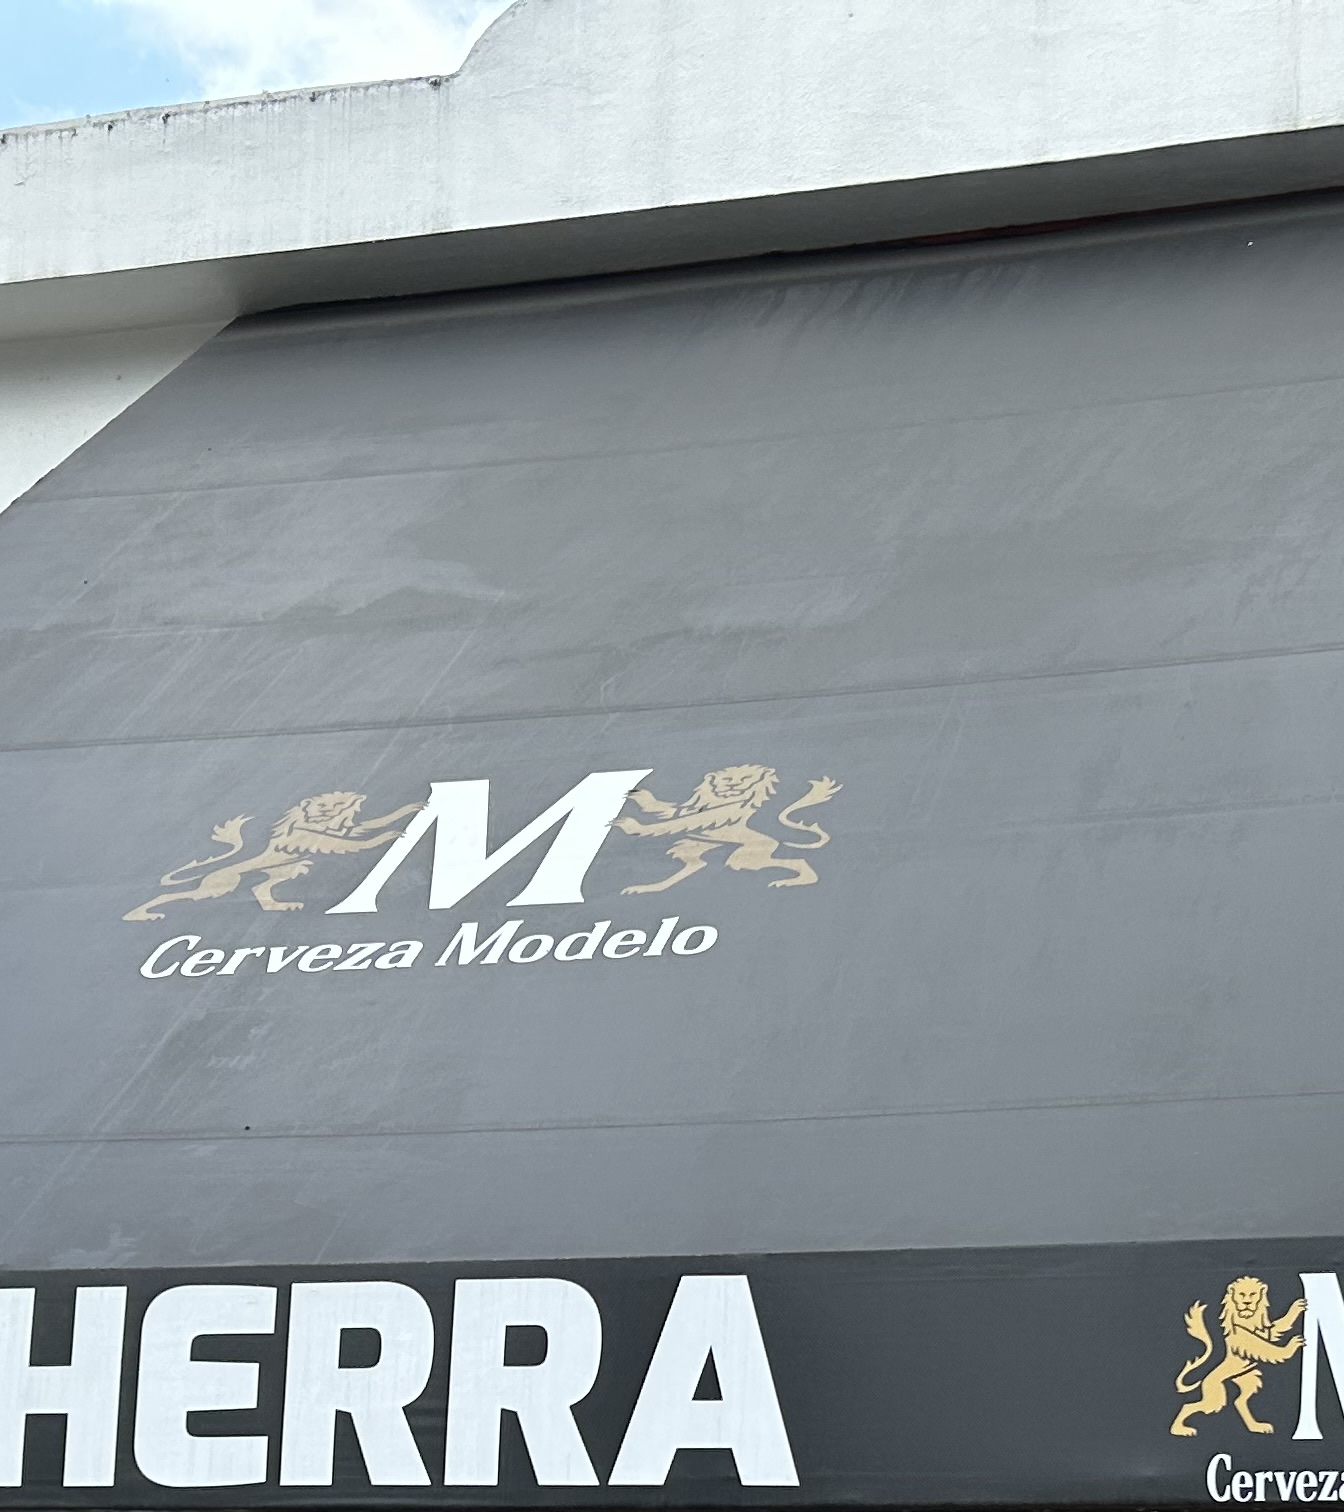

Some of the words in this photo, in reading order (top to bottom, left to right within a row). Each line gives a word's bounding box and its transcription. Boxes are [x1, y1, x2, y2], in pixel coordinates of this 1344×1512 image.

[325, 769, 653, 914] M
[140, 935, 424, 979] Cerveza
[434, 916, 719, 968] Modelo
